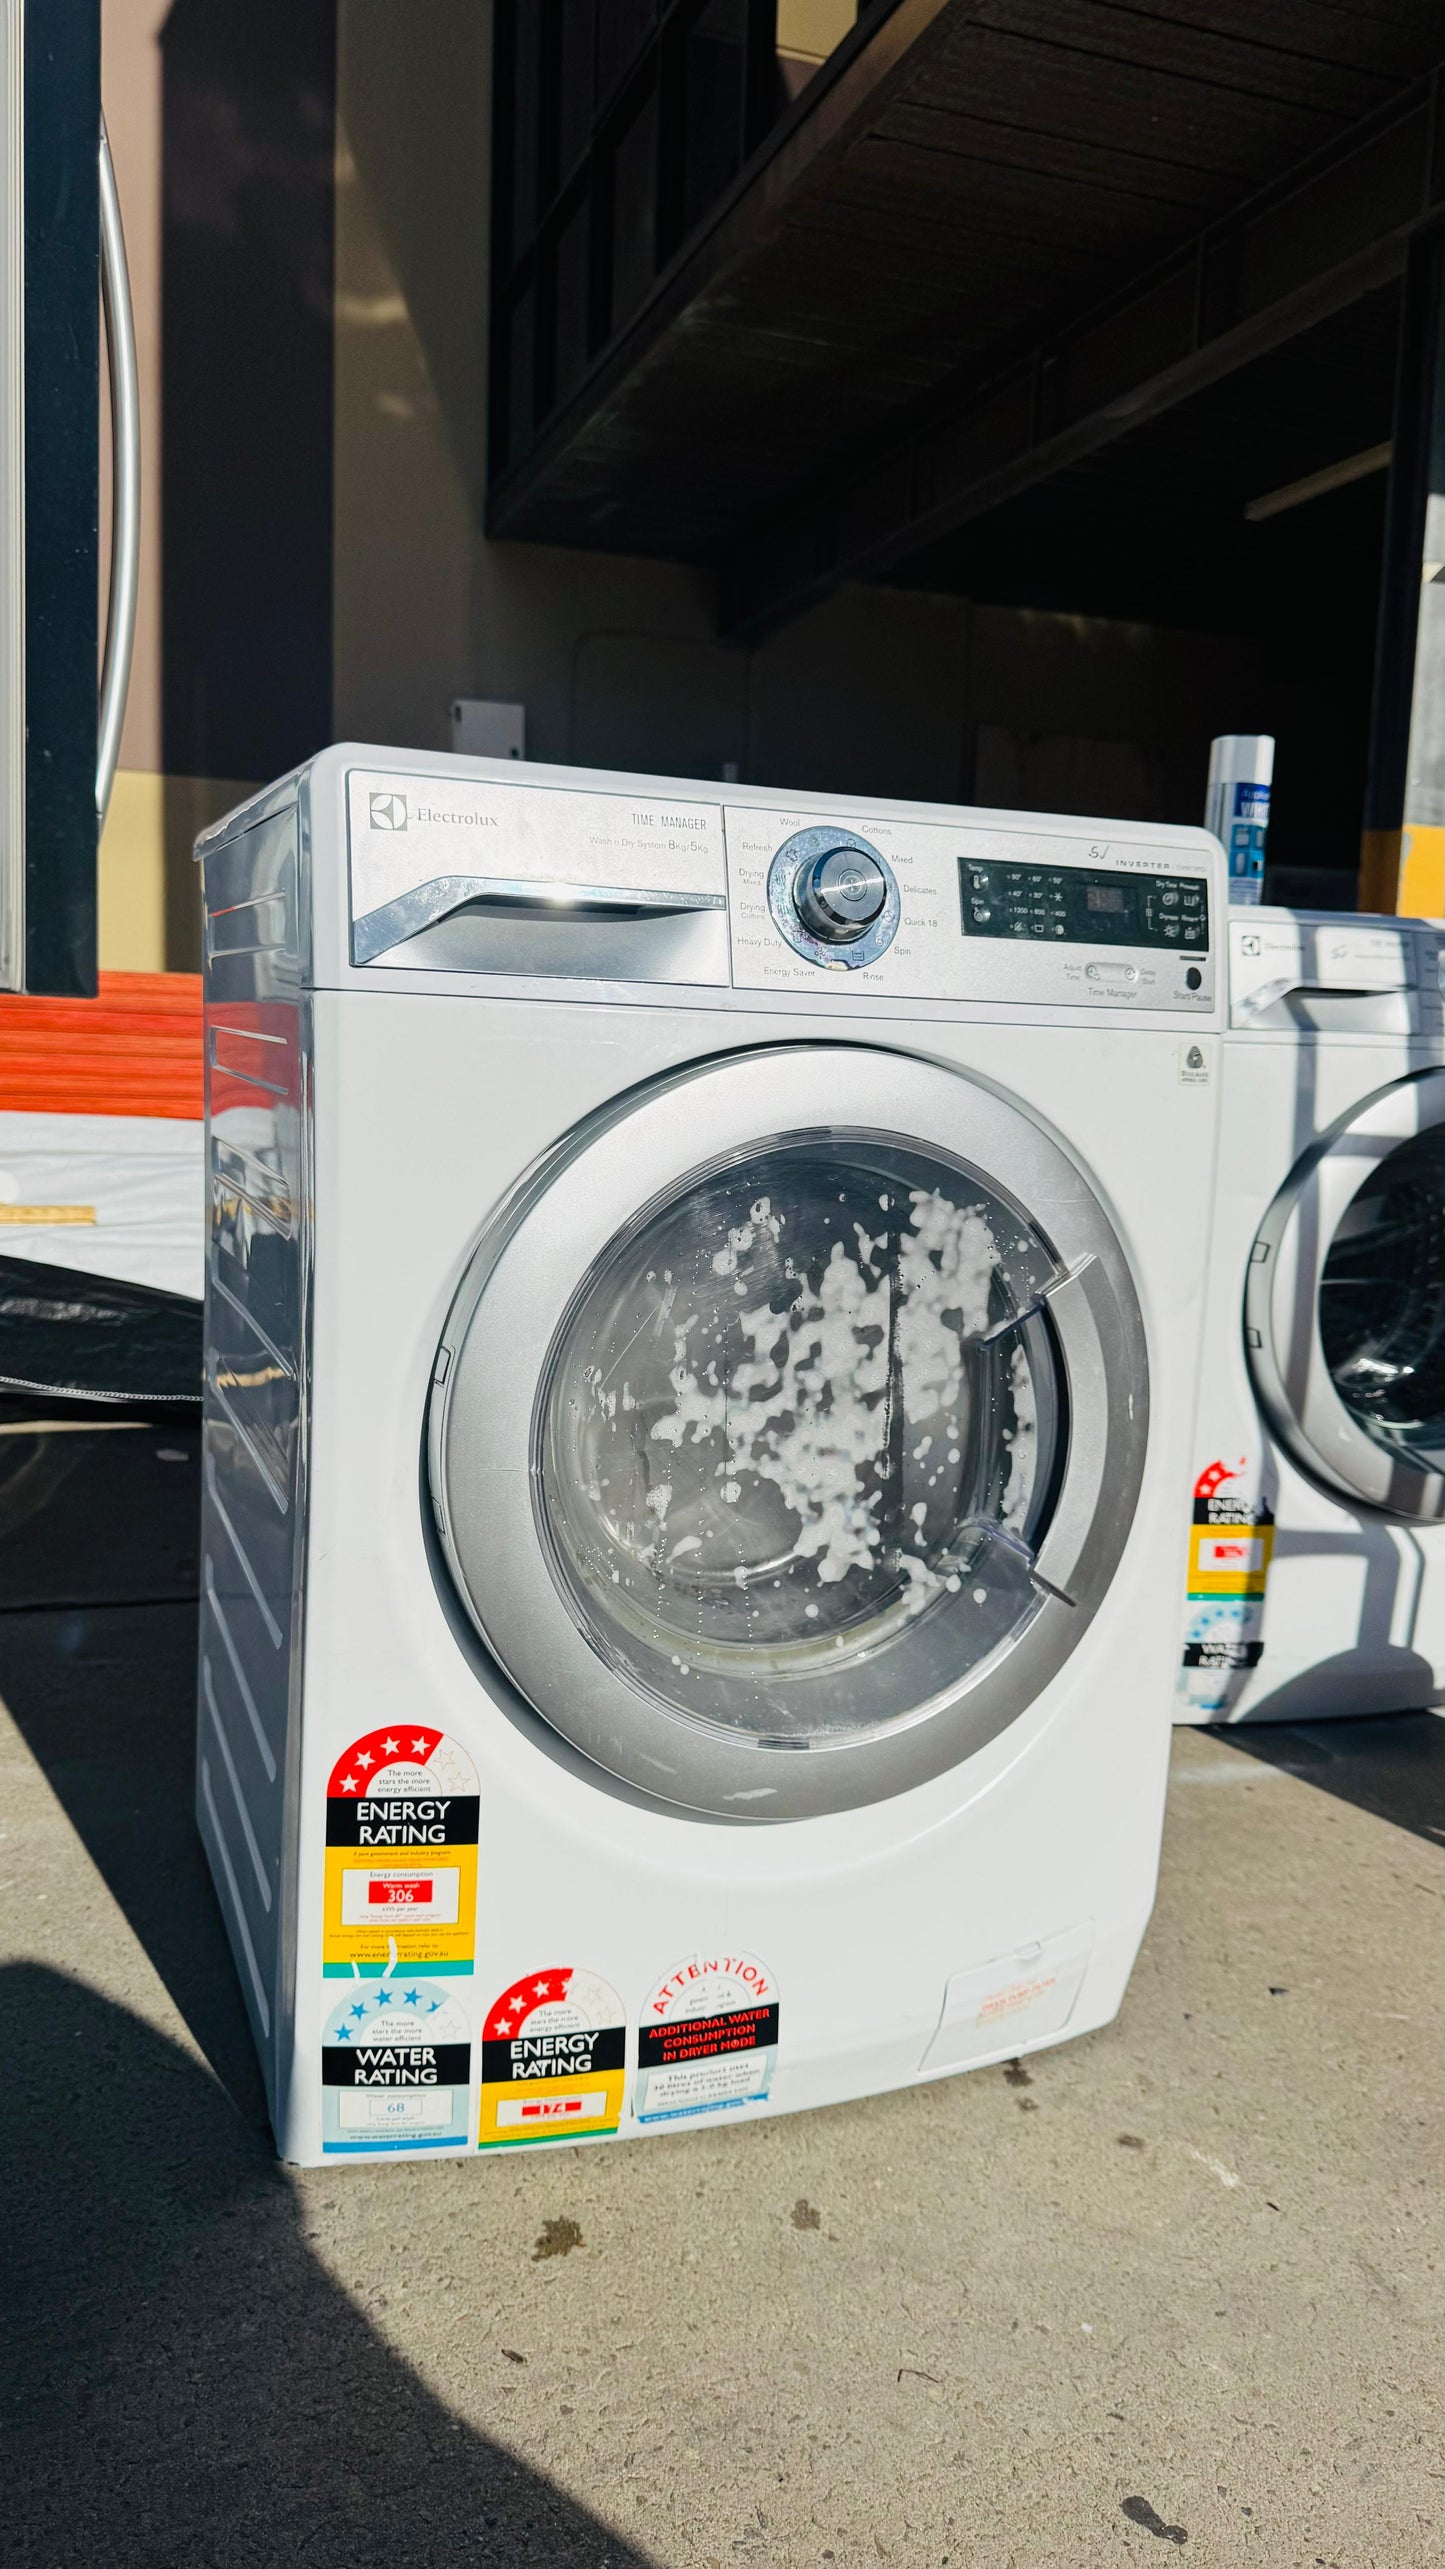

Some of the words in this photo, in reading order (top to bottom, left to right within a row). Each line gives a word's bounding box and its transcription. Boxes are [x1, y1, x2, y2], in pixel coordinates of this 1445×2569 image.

[417, 807, 500, 827] Electrolux
[632, 813, 655, 827] TIME
[661, 815, 707, 831] MANAGER
[779, 817, 801, 828] Wool
[861, 824, 892, 836] Cottons
[621, 838, 635, 848] Dry
[637, 839, 667, 850] System
[742, 842, 773, 853] Refresh
[891, 854, 914, 865] Mixed
[1115, 860, 1171, 870] INVERTER
[738, 867, 765, 880] Drying
[903, 884, 938, 896] Delicates
[740, 901, 766, 913] Drying
[904, 917, 926, 928] Quick
[737, 936, 762, 948] Heavy
[763, 937, 782, 949] Duty
[893, 946, 912, 957] Spin
[763, 967, 791, 979] Energy
[792, 967, 816, 978] Saver
[862, 971, 884, 982] Rinse
[1088, 987, 1105, 997] Time
[1106, 988, 1138, 1000] Manager
[387, 1769, 401, 1777] The
[377, 1786, 401, 1794] energy
[403, 1785, 431, 1793] efficient
[356, 1800, 451, 1821] ENERGY
[359, 1824, 446, 1845] RATING
[370, 1871, 391, 1879] Energy
[393, 1870, 434, 1879] consumption
[387, 1888, 414, 1904] 306
[652, 1957, 769, 2016] ATTENTION
[649, 2016, 728, 2040] ADDITIONAL
[729, 2007, 770, 2025] WATER
[663, 2023, 756, 2049] CONSUMPTION
[510, 2032, 599, 2060] ENERGY
[662, 2050, 677, 2062] IN
[679, 2042, 718, 2060] DRYER
[720, 2035, 756, 2051] MODE
[355, 2047, 437, 2067] WATER
[512, 2054, 592, 2080] RATING
[354, 2068, 438, 2086] RATING
[386, 2102, 406, 2114] 68
